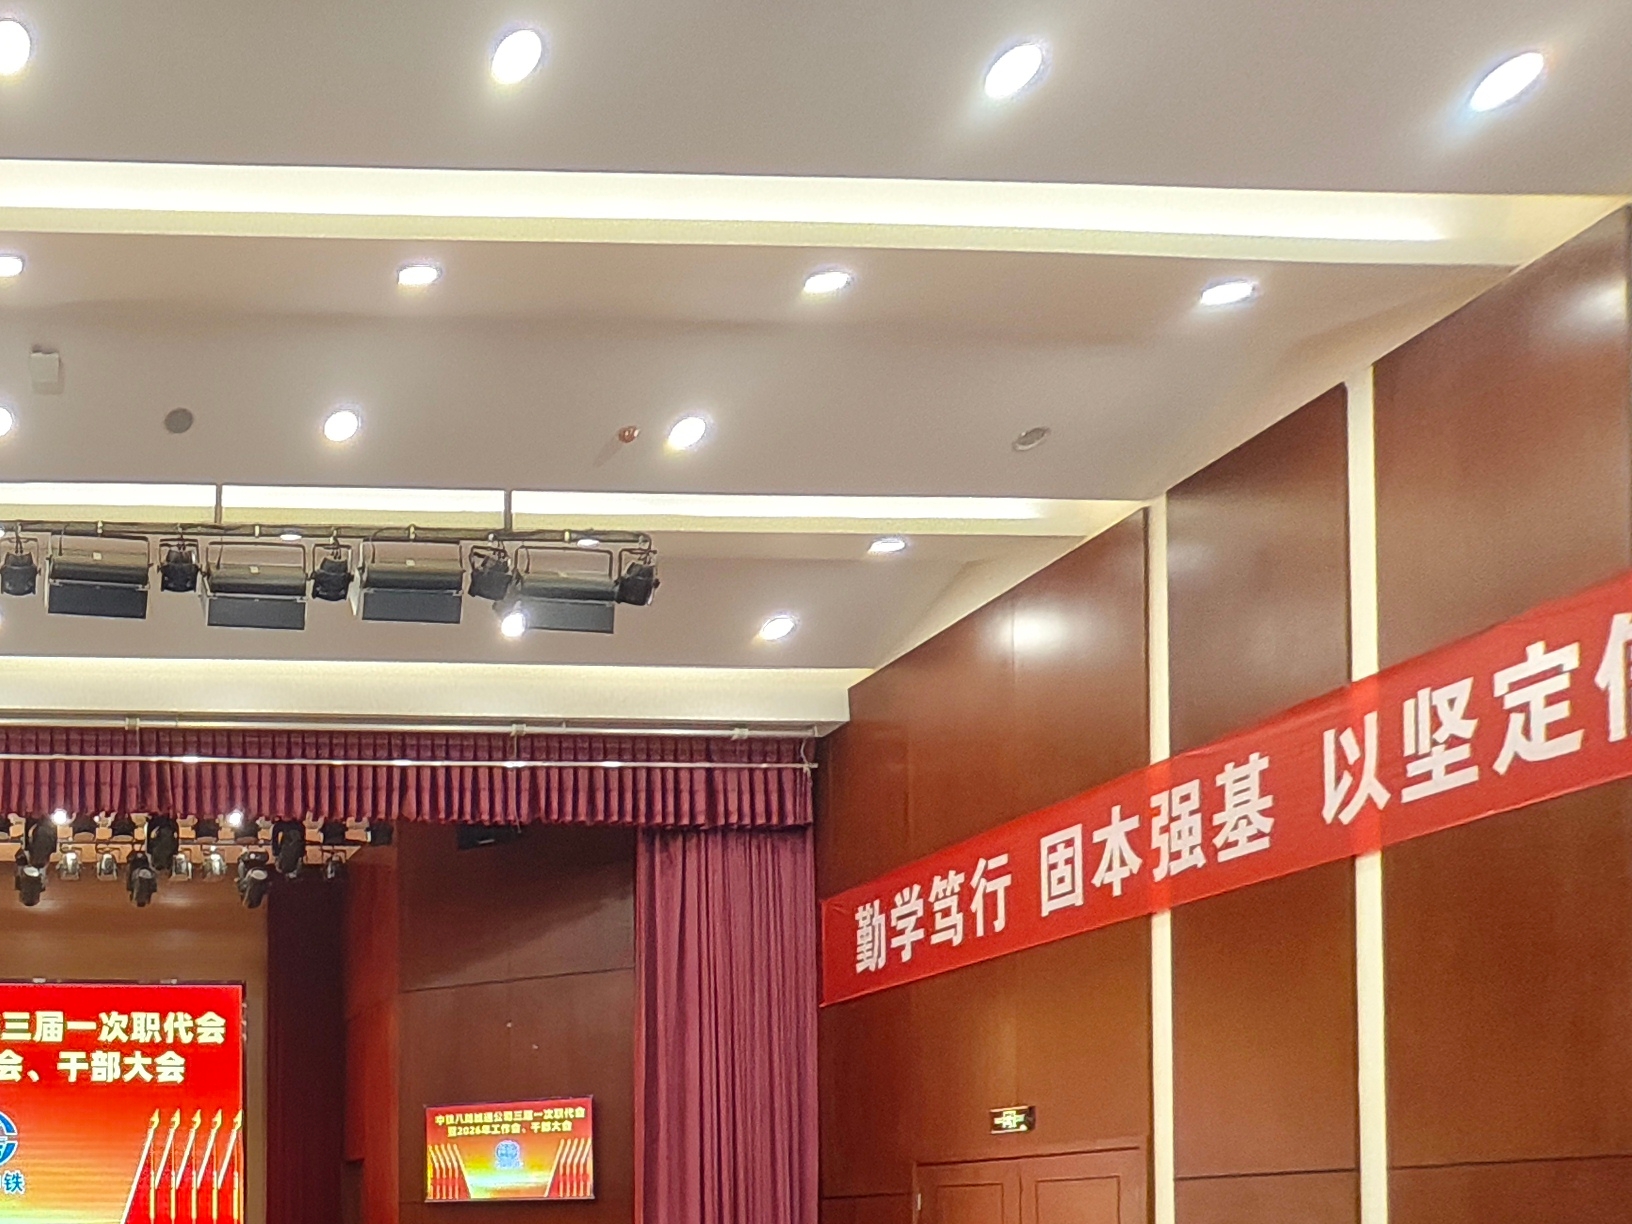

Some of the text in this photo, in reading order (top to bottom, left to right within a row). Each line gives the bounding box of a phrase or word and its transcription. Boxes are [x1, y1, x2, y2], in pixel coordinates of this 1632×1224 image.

[853, 850, 1013, 975] 勤学笃行
[1039, 752, 1275, 917] 固本强基
